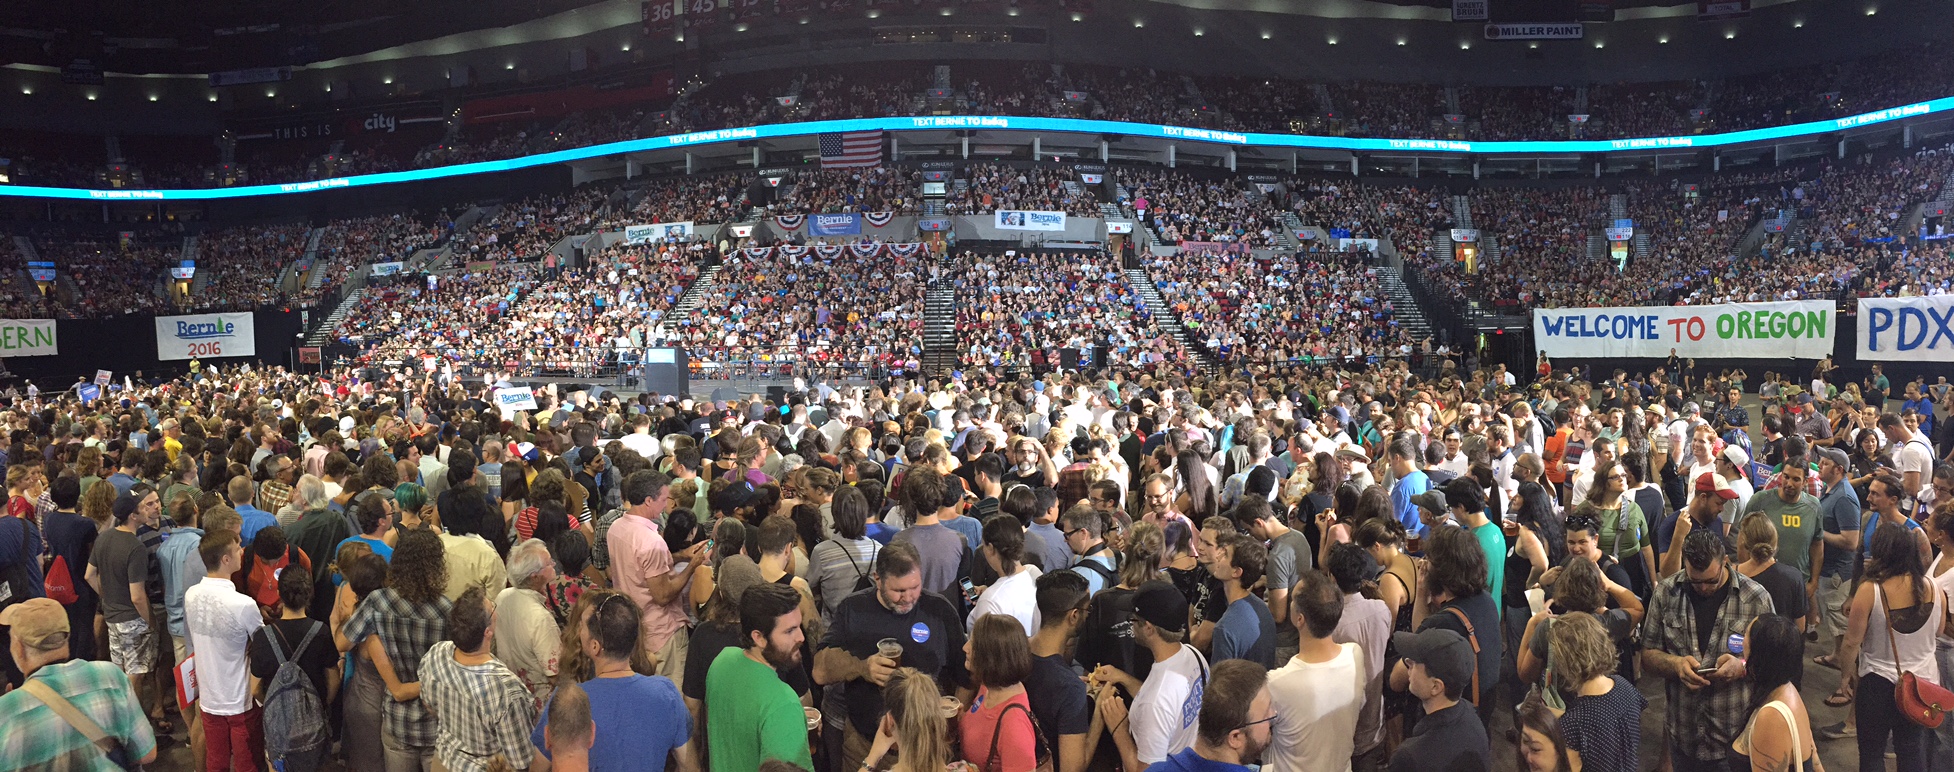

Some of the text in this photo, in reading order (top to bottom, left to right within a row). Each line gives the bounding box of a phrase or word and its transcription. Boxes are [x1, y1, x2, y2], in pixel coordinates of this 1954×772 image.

[651, 2, 672, 22] 36
[692, 0, 715, 14] 45
[1456, 1, 1484, 9] LORENTZ
[1501, 26, 1581, 36] MILLER PAINT
[364, 113, 396, 133] city
[913, 118, 933, 126] TEXT
[967, 117, 981, 125] TO
[1837, 117, 1857, 126] TEXT
[1858, 112, 1886, 123] BERNIE
[275, 124, 332, 140] THIS IS
[669, 135, 687, 143] TEXT
[689, 132, 717, 141] BERNIE
[719, 130, 731, 138] TO
[1184, 129, 1209, 138] BERNIE
[817, 214, 853, 224] Bernie
[1031, 213, 1061, 223] Bernie
[628, 227, 655, 237] Bernie
[1188, 242, 1219, 251] Bernie
[177, 321, 234, 335] Bernie
[1541, 310, 1827, 343] WELCOME TO OREGON
[1869, 306, 1954, 352] PDX
[0, 326, 53, 350] ERN
[188, 342, 221, 356] 2016
[501, 391, 531, 403] Bernie
[1782, 514, 1801, 528] UO
